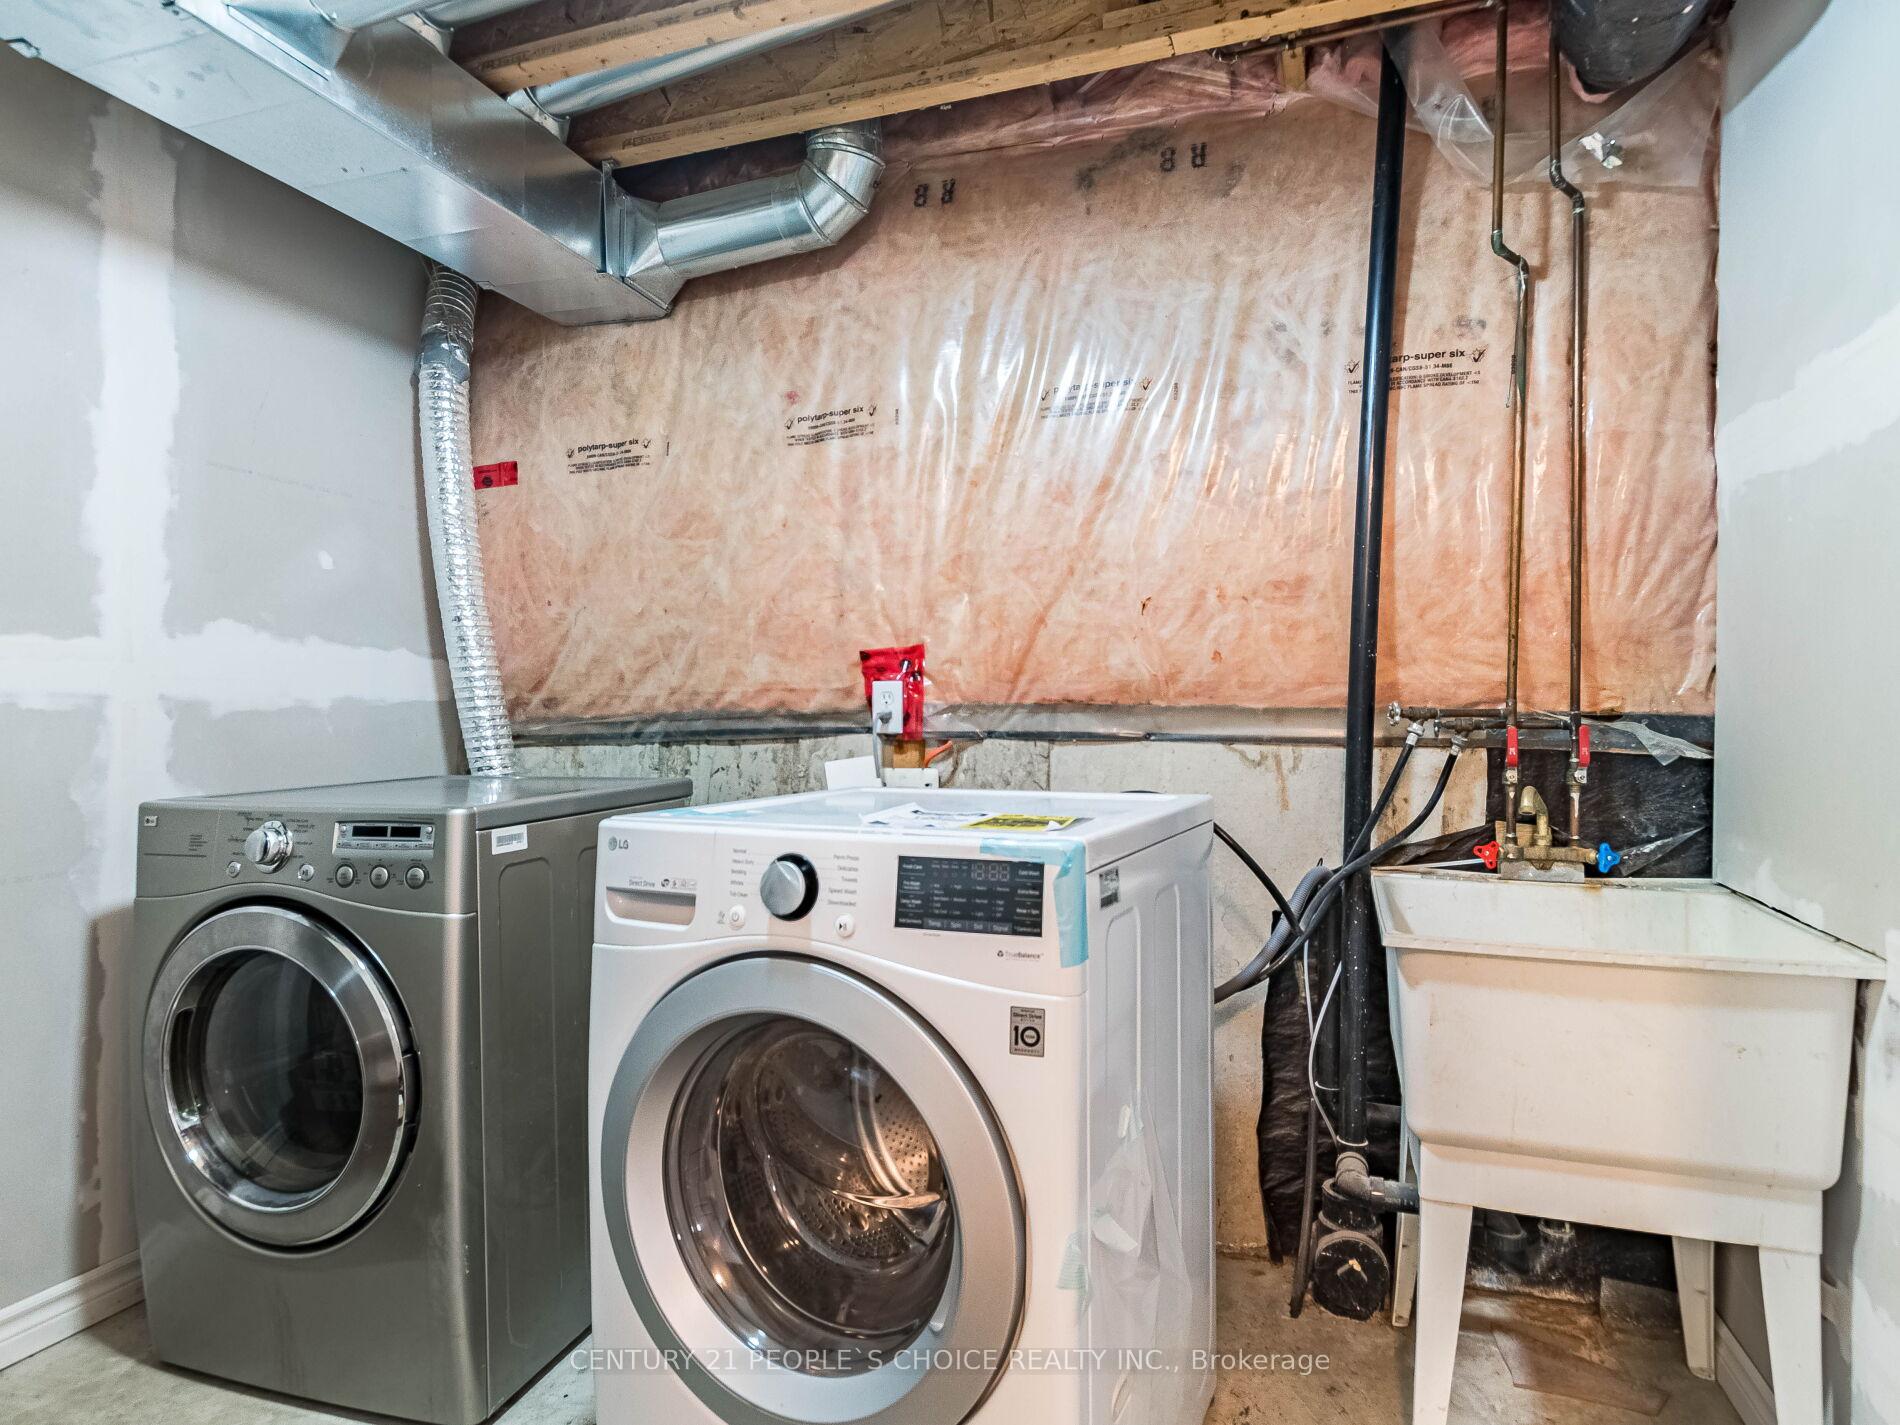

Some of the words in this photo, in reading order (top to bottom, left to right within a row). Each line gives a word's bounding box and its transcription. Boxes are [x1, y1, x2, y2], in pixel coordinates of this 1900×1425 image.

[1391, 350, 1446, 363] arp-super
[1449, 348, 1465, 358] six
[797, 408, 851, 424] polytarp-super
[852, 405, 864, 414] six
[577, 439, 627, 454] polytarp-super
[628, 437, 639, 446] six
[618, 839, 629, 850] LG
[1013, 1025, 1041, 1047] 10
